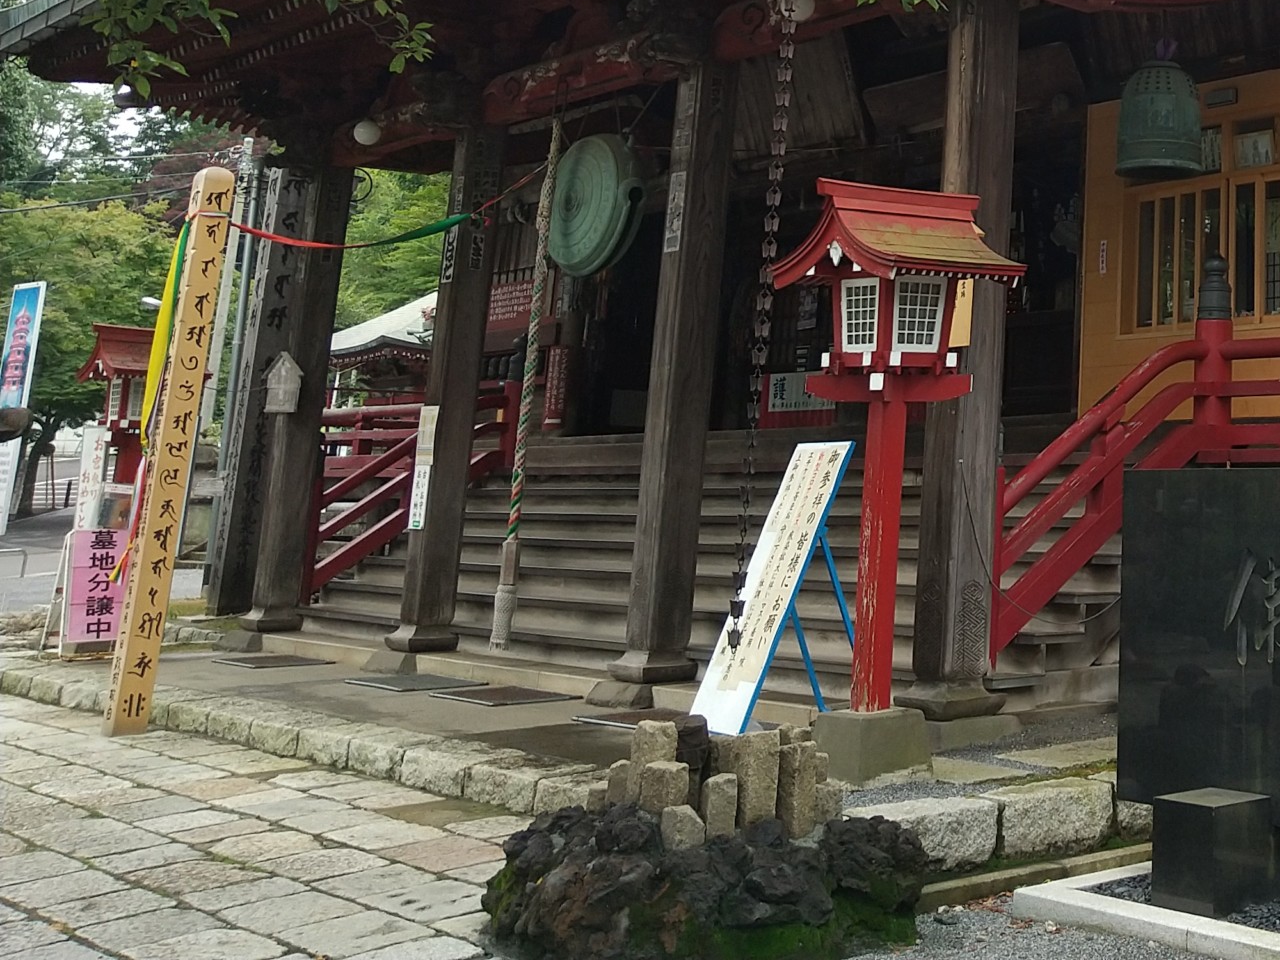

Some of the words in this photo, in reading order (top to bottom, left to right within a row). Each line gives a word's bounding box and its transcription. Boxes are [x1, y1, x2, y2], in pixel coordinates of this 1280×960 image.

[85, 530, 118, 639] 墓地分譲中
